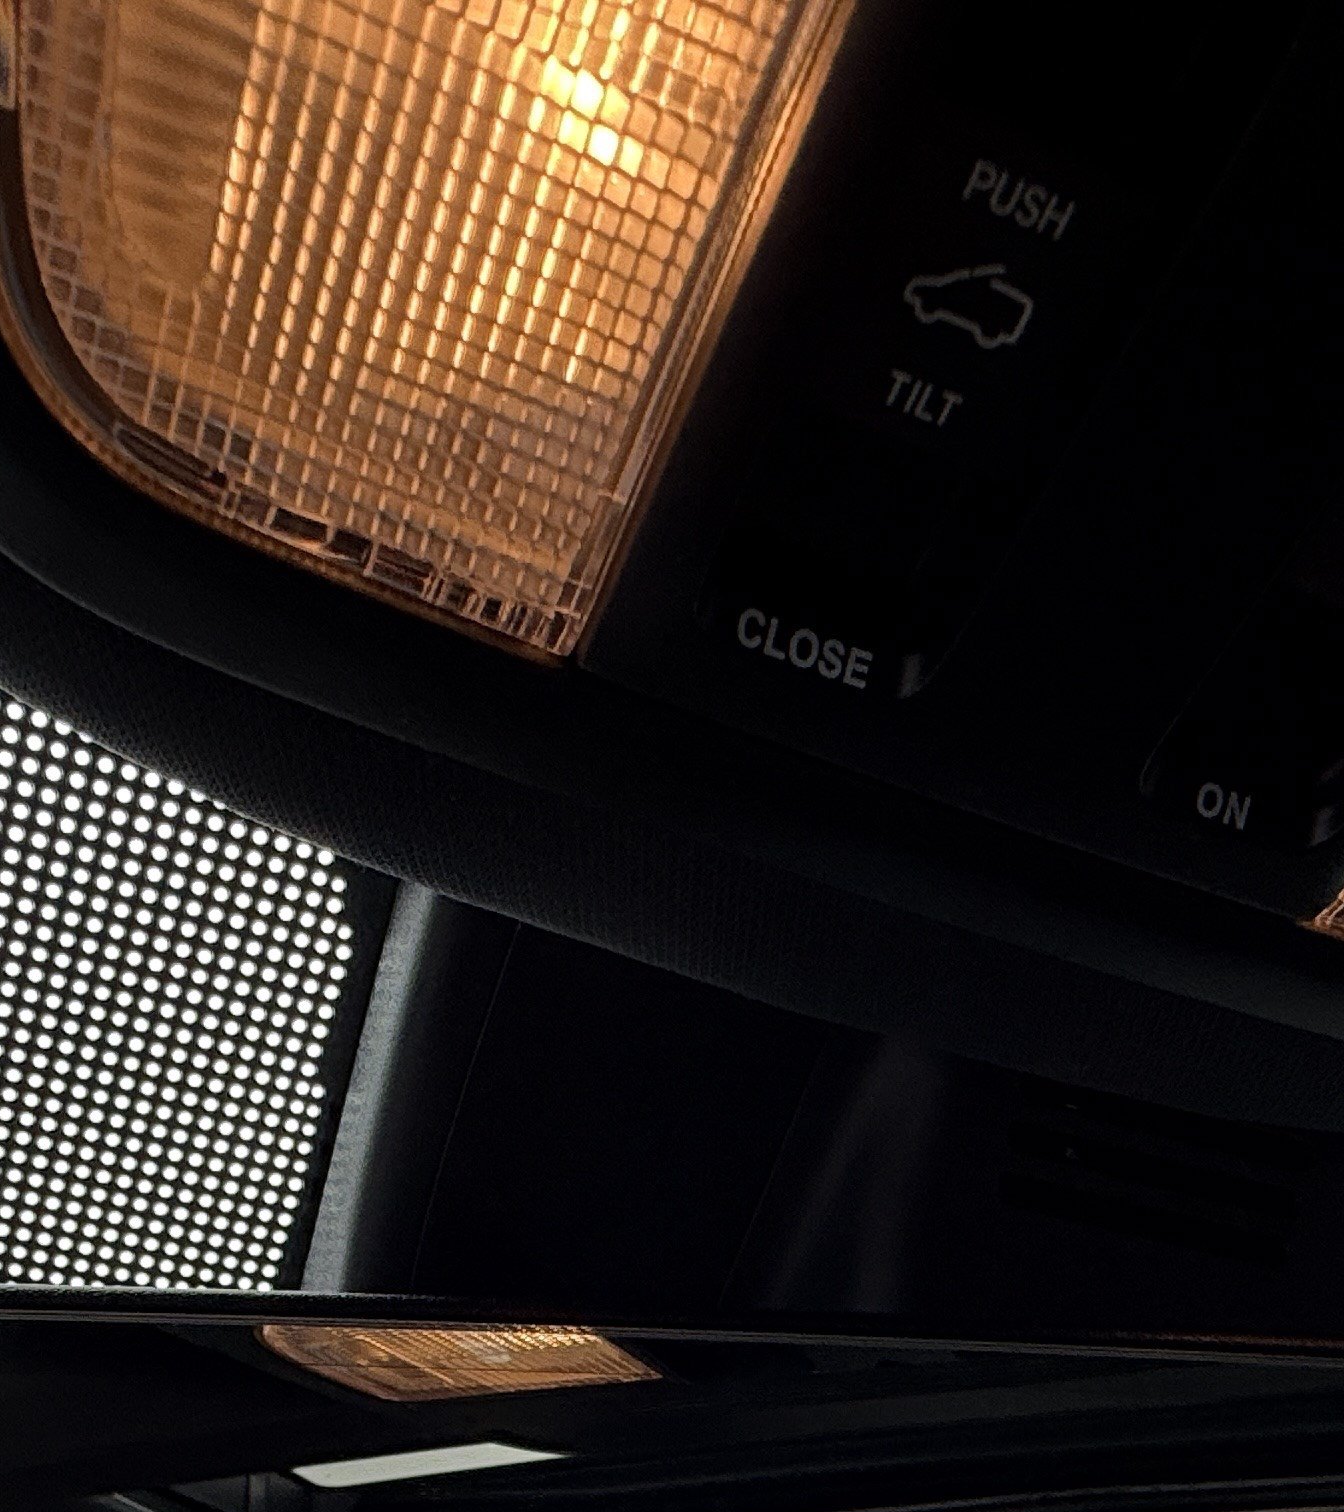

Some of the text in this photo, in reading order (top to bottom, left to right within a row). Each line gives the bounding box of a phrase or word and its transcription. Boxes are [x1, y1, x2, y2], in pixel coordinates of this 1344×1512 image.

[962, 158, 1077, 241] PUSH
[881, 367, 964, 428] TILT
[736, 607, 874, 689] CLOSE
[1196, 781, 1252, 831] ON
